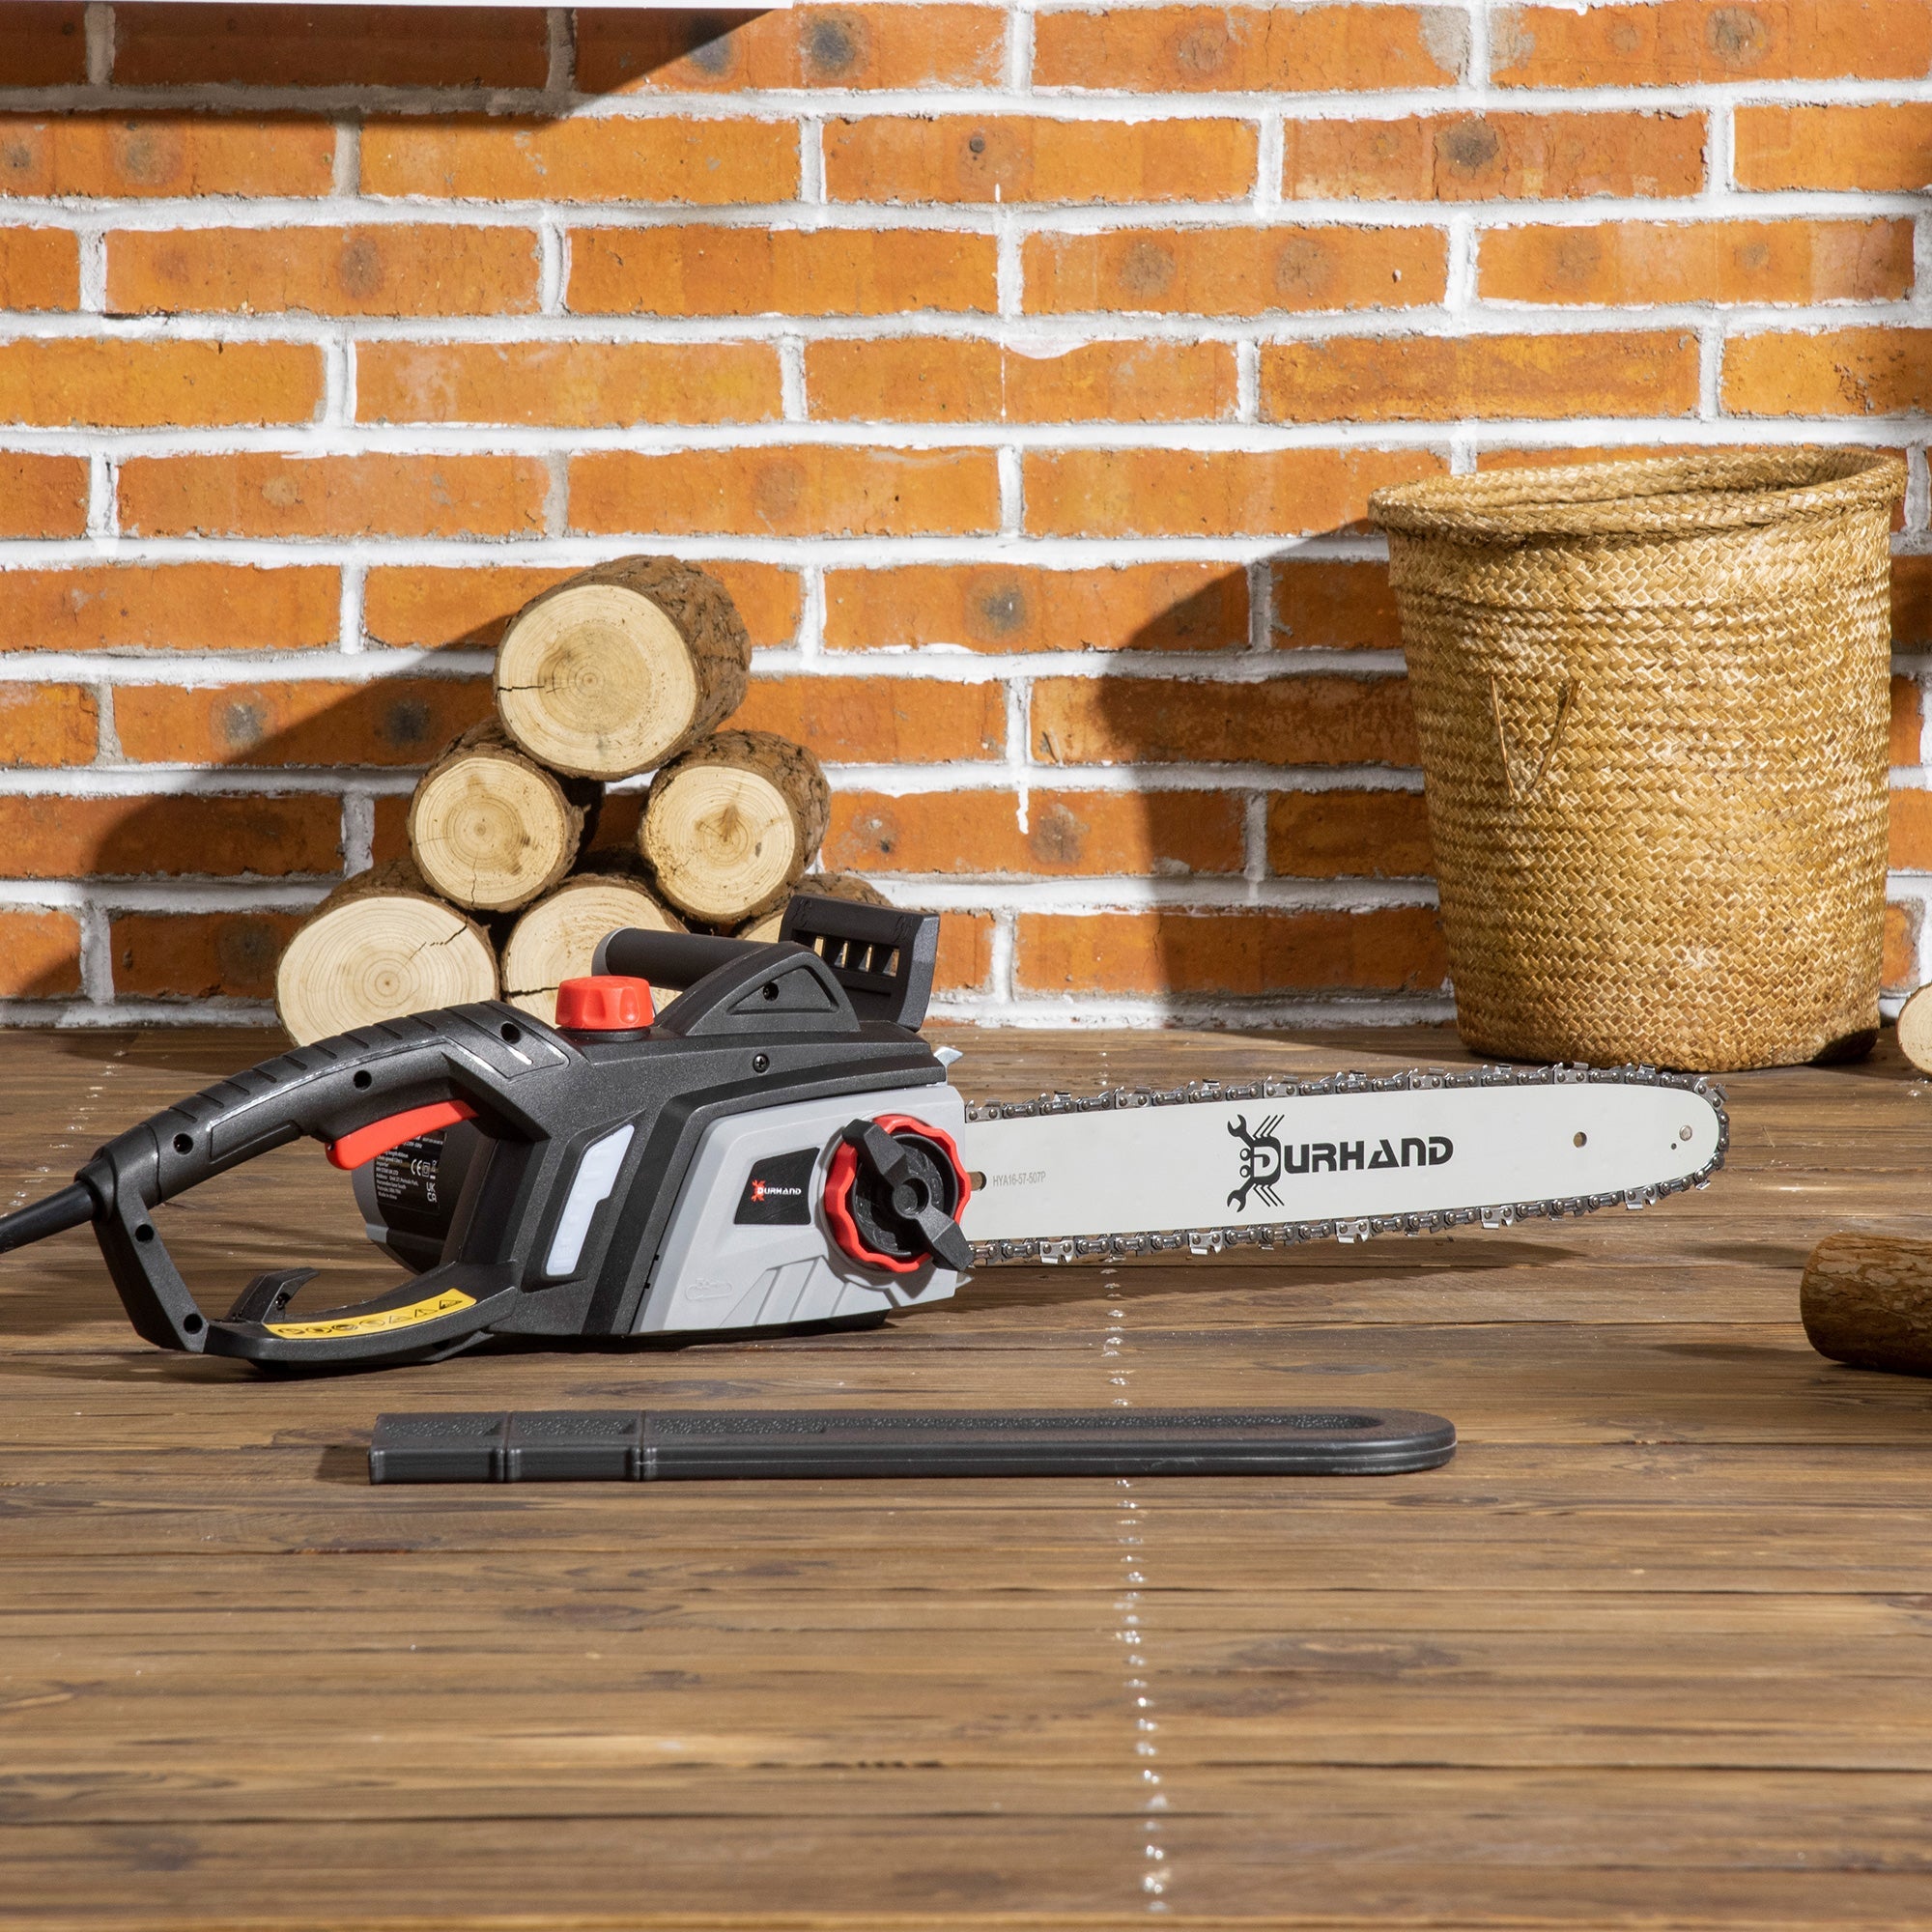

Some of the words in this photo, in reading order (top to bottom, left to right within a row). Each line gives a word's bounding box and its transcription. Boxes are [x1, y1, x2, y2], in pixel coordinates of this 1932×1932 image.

[1250, 1130, 1454, 1185] DURHAND
[426, 1181, 436, 1192] UK
[756, 1186, 802, 1196] DURHAND
